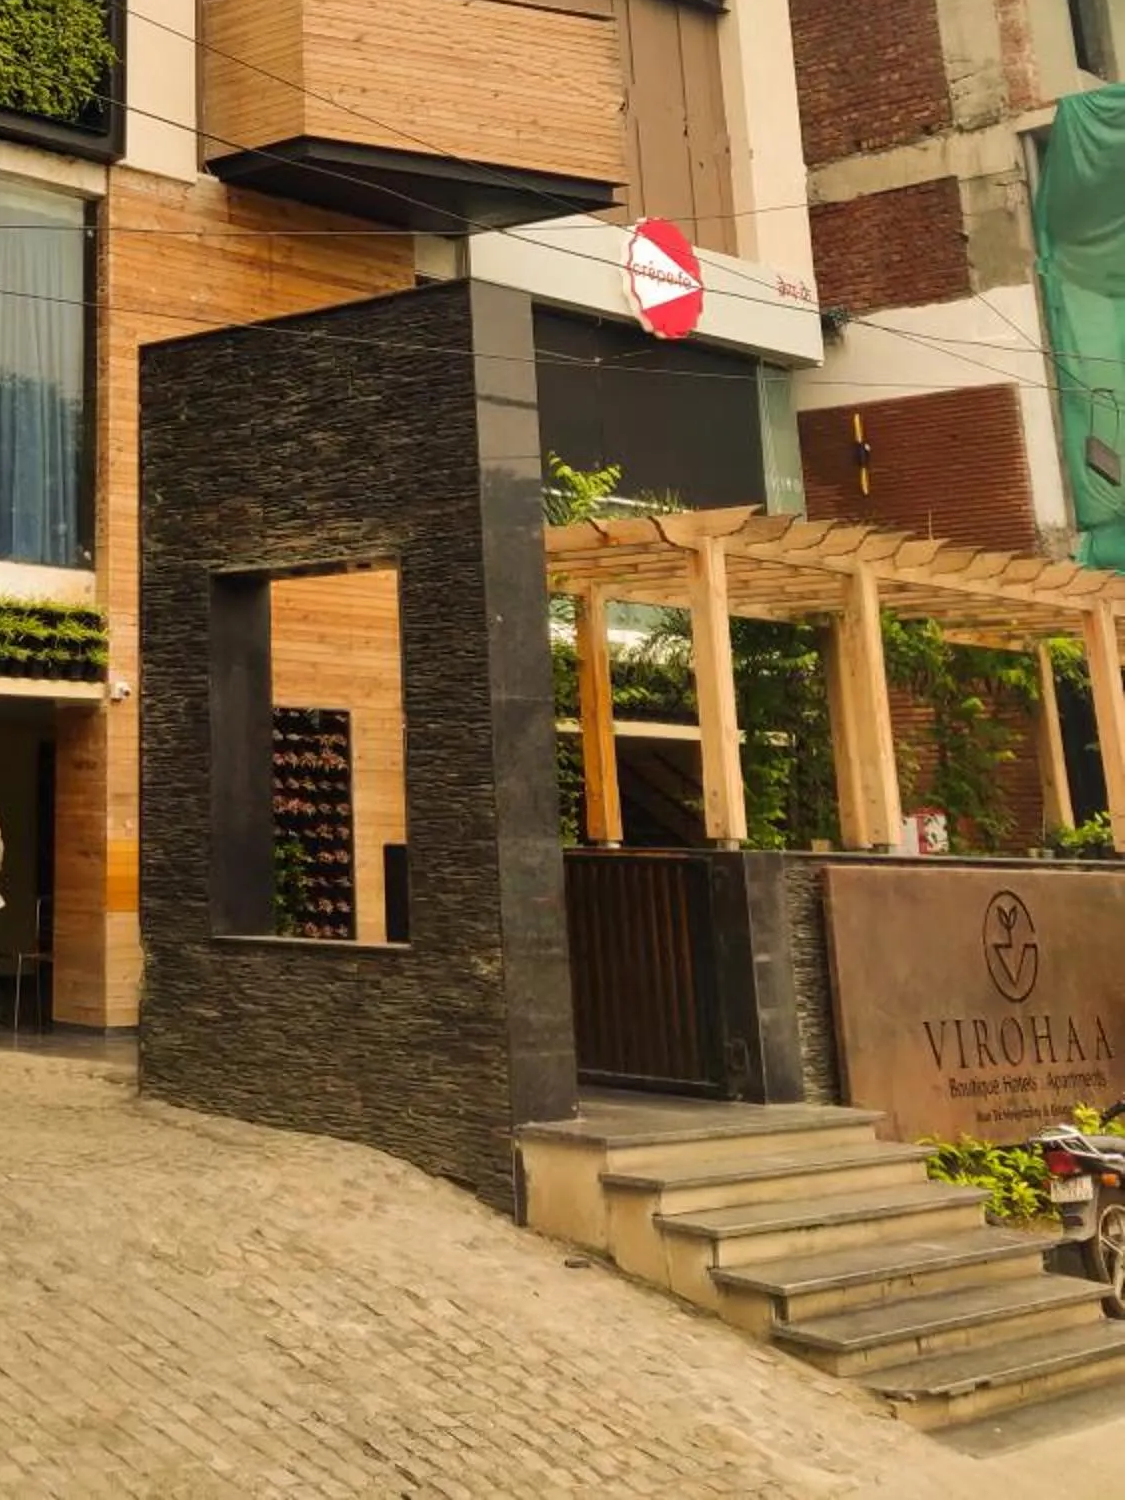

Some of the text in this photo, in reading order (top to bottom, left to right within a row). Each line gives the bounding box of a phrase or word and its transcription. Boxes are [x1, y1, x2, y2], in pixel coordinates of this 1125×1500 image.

[922, 1014, 1116, 1072] VIROHAA
[949, 1078, 1000, 1100] Boutique
[1002, 1074, 1038, 1094] Hotels
